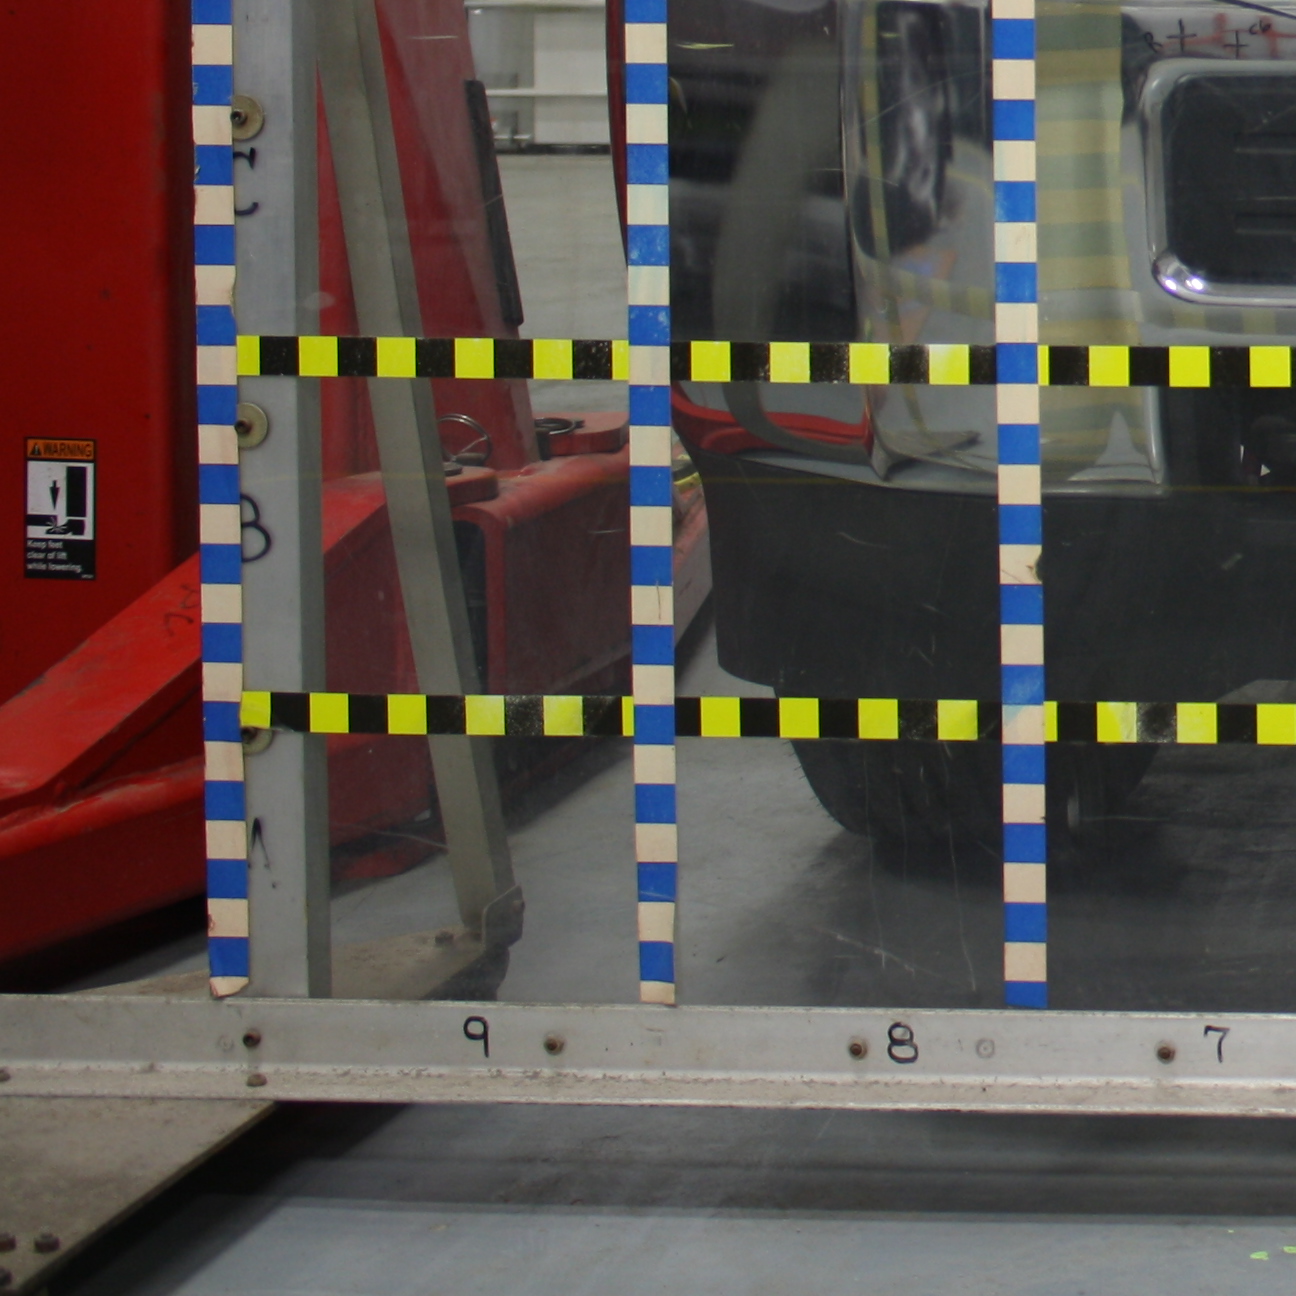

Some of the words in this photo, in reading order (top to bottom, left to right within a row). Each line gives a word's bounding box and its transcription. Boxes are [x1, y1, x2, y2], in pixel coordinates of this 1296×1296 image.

[43, 441, 93, 458] WARNING
[462, 1015, 492, 1059] 9
[886, 1020, 920, 1064] 8
[1203, 1025, 1231, 1064] 7
